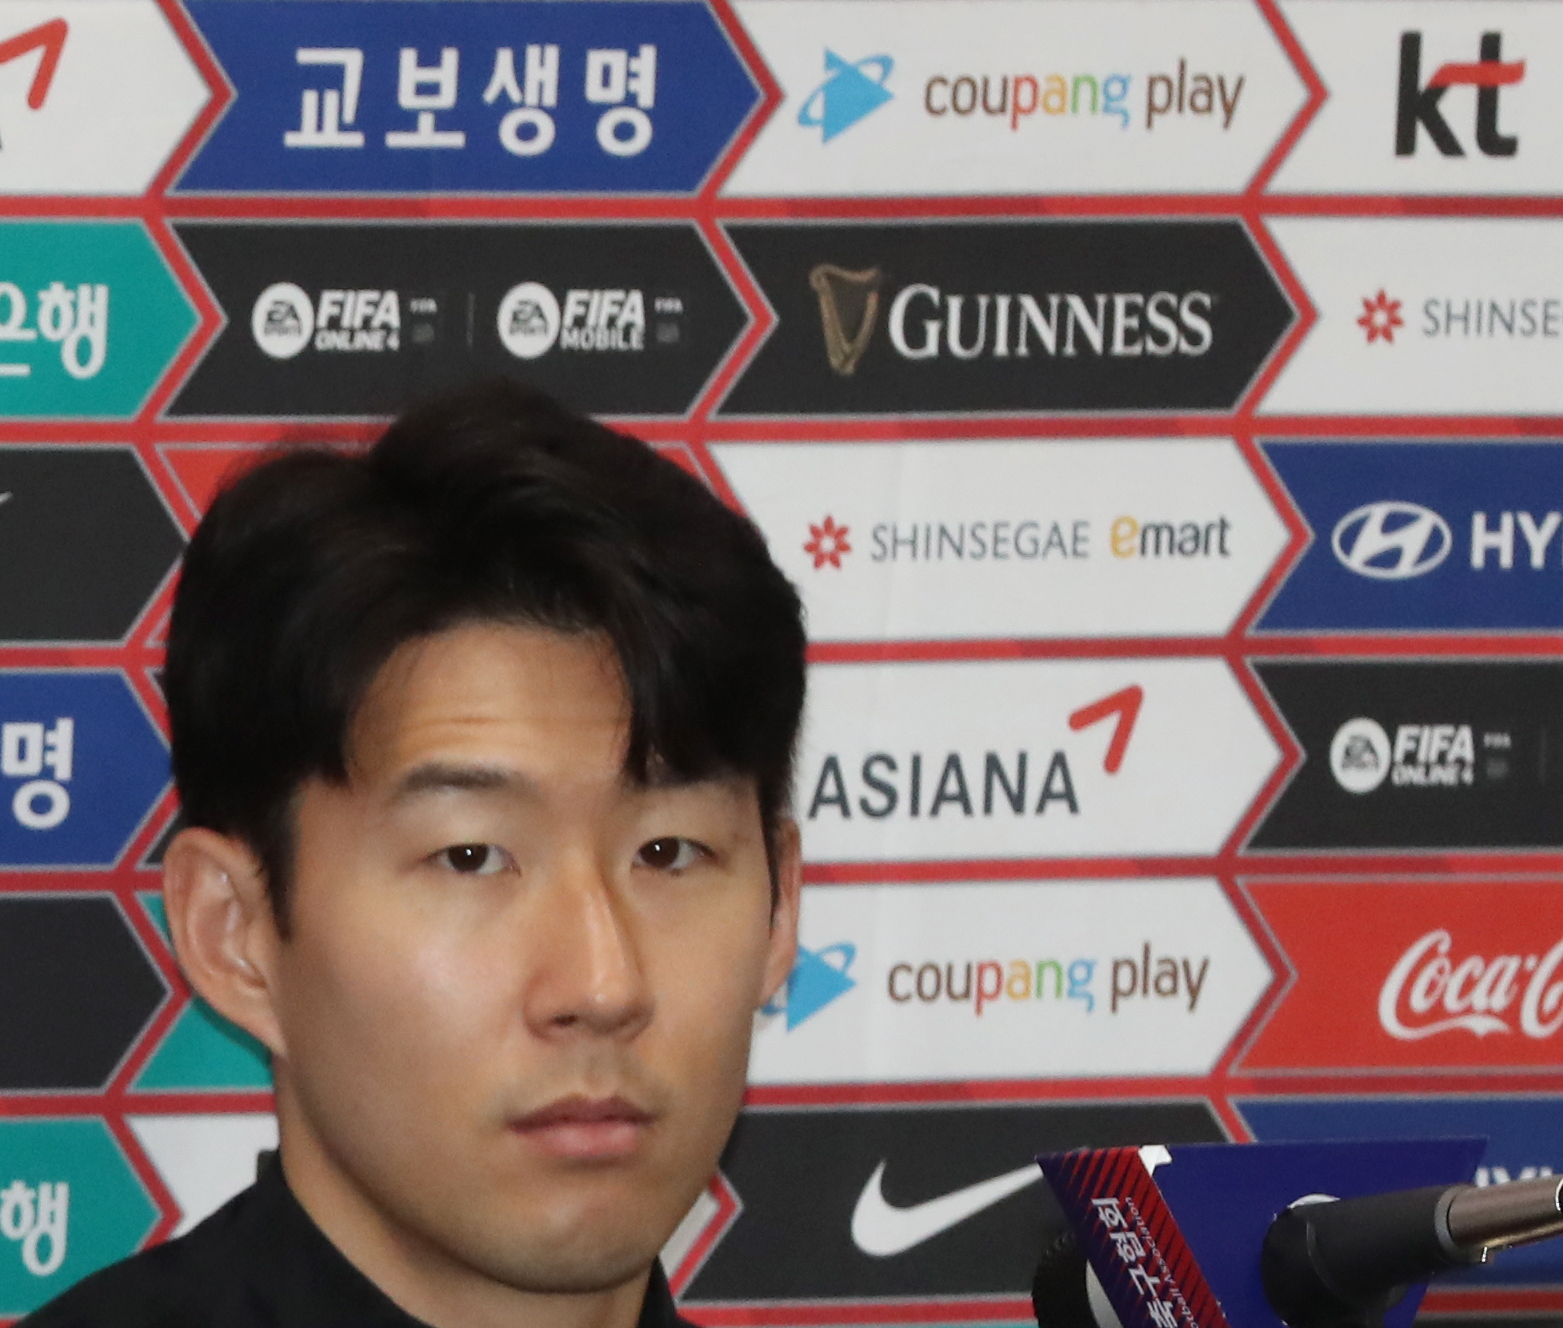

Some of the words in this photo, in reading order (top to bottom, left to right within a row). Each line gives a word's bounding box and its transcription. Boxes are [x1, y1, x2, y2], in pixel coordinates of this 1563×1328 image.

[284, 45, 656, 156] 교보생명
[925, 75, 1130, 130] coupang
[1146, 58, 1244, 129] play
[1395, 31, 1525, 157] kt
[316, 289, 401, 329] FIFA
[560, 329, 644, 352] MOBILE
[562, 289, 646, 329] FIFA
[889, 284, 1212, 359] GUINNESS
[872, 521, 1089, 562] SHINSEGAE
[1111, 516, 1229, 558] emart
[1394, 724, 1474, 763] FIFA
[808, 751, 1079, 819] ASIANA
[888, 960, 1095, 1016] coupang
[1111, 943, 1209, 1014] play
